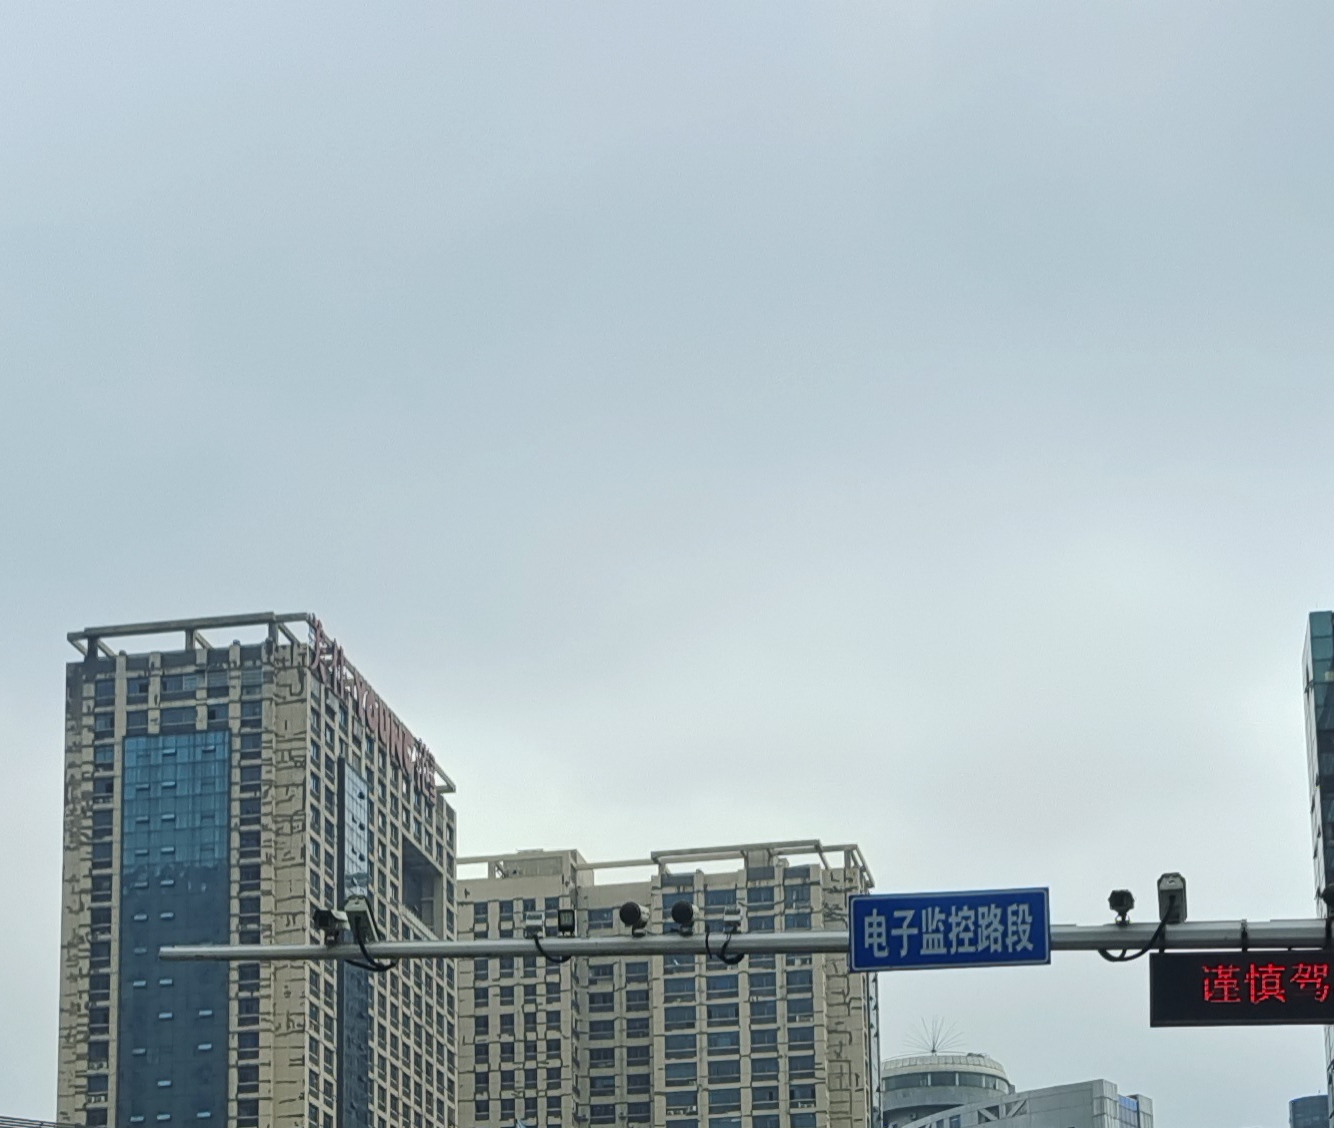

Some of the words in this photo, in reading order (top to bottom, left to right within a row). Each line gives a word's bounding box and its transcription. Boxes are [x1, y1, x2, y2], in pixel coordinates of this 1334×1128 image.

[863, 902, 1035, 959] 电子监控路段
